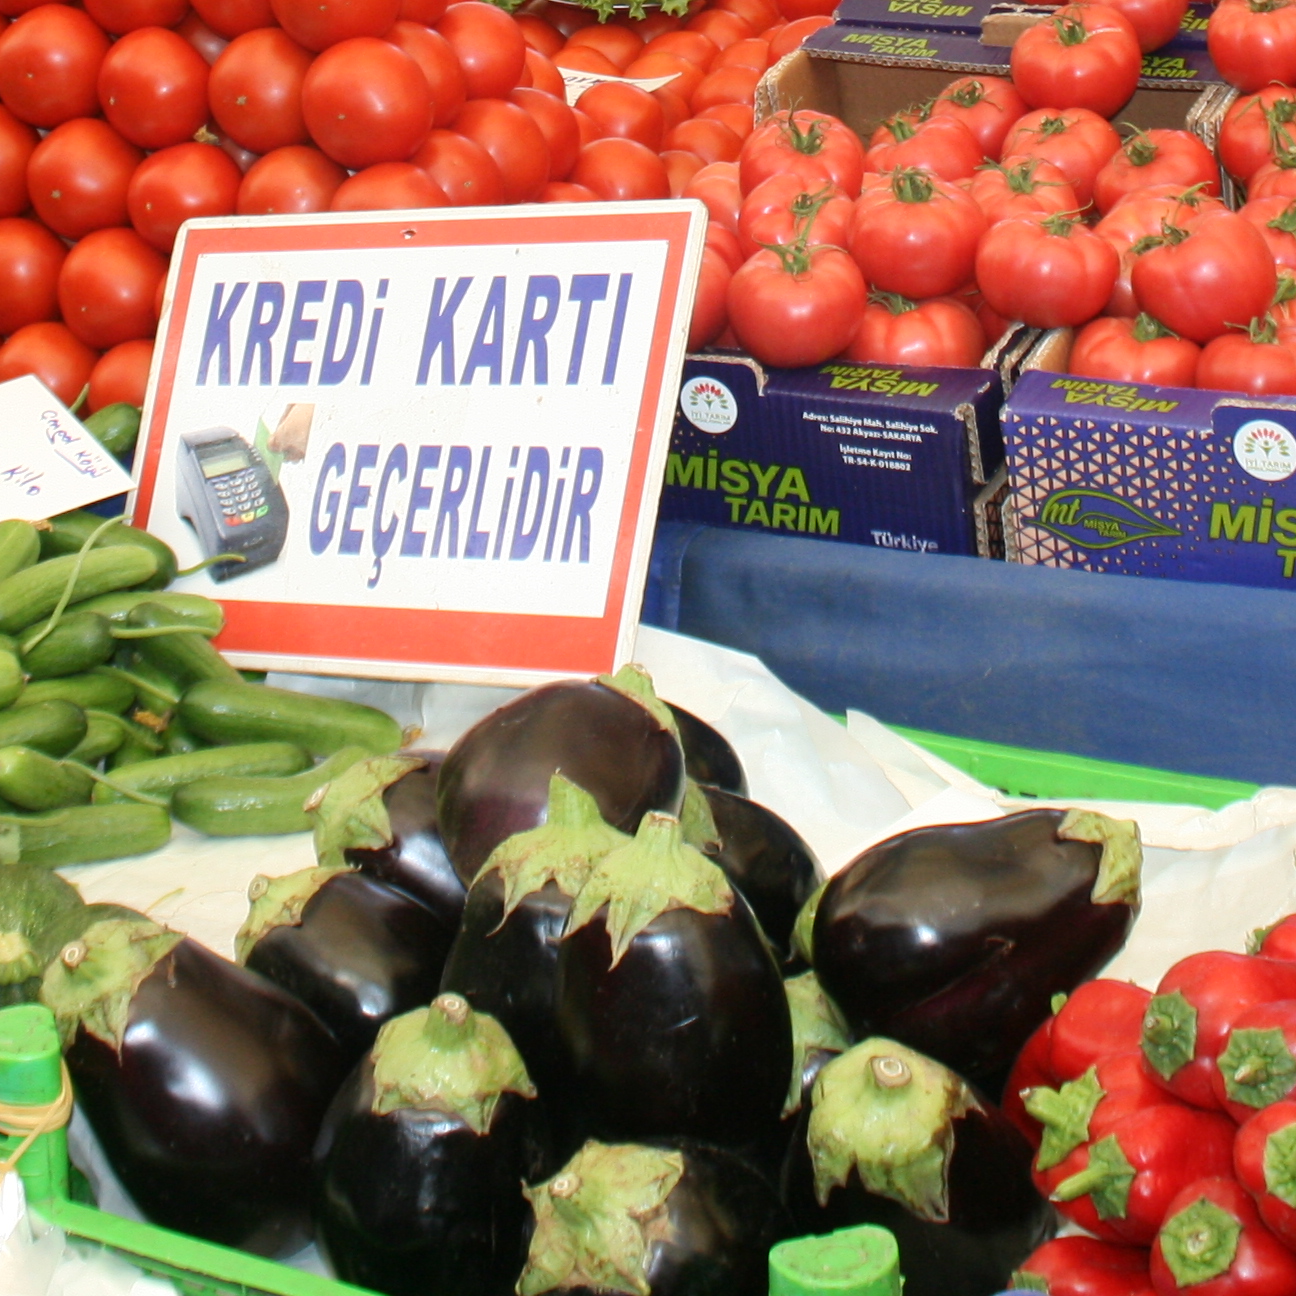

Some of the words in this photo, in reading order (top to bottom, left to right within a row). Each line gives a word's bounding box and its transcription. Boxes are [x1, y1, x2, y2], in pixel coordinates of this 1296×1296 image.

[415, 272, 633, 386] KARTI
[724, 496, 840, 536] TARIM
[870, 530, 939, 553] Türkiye
